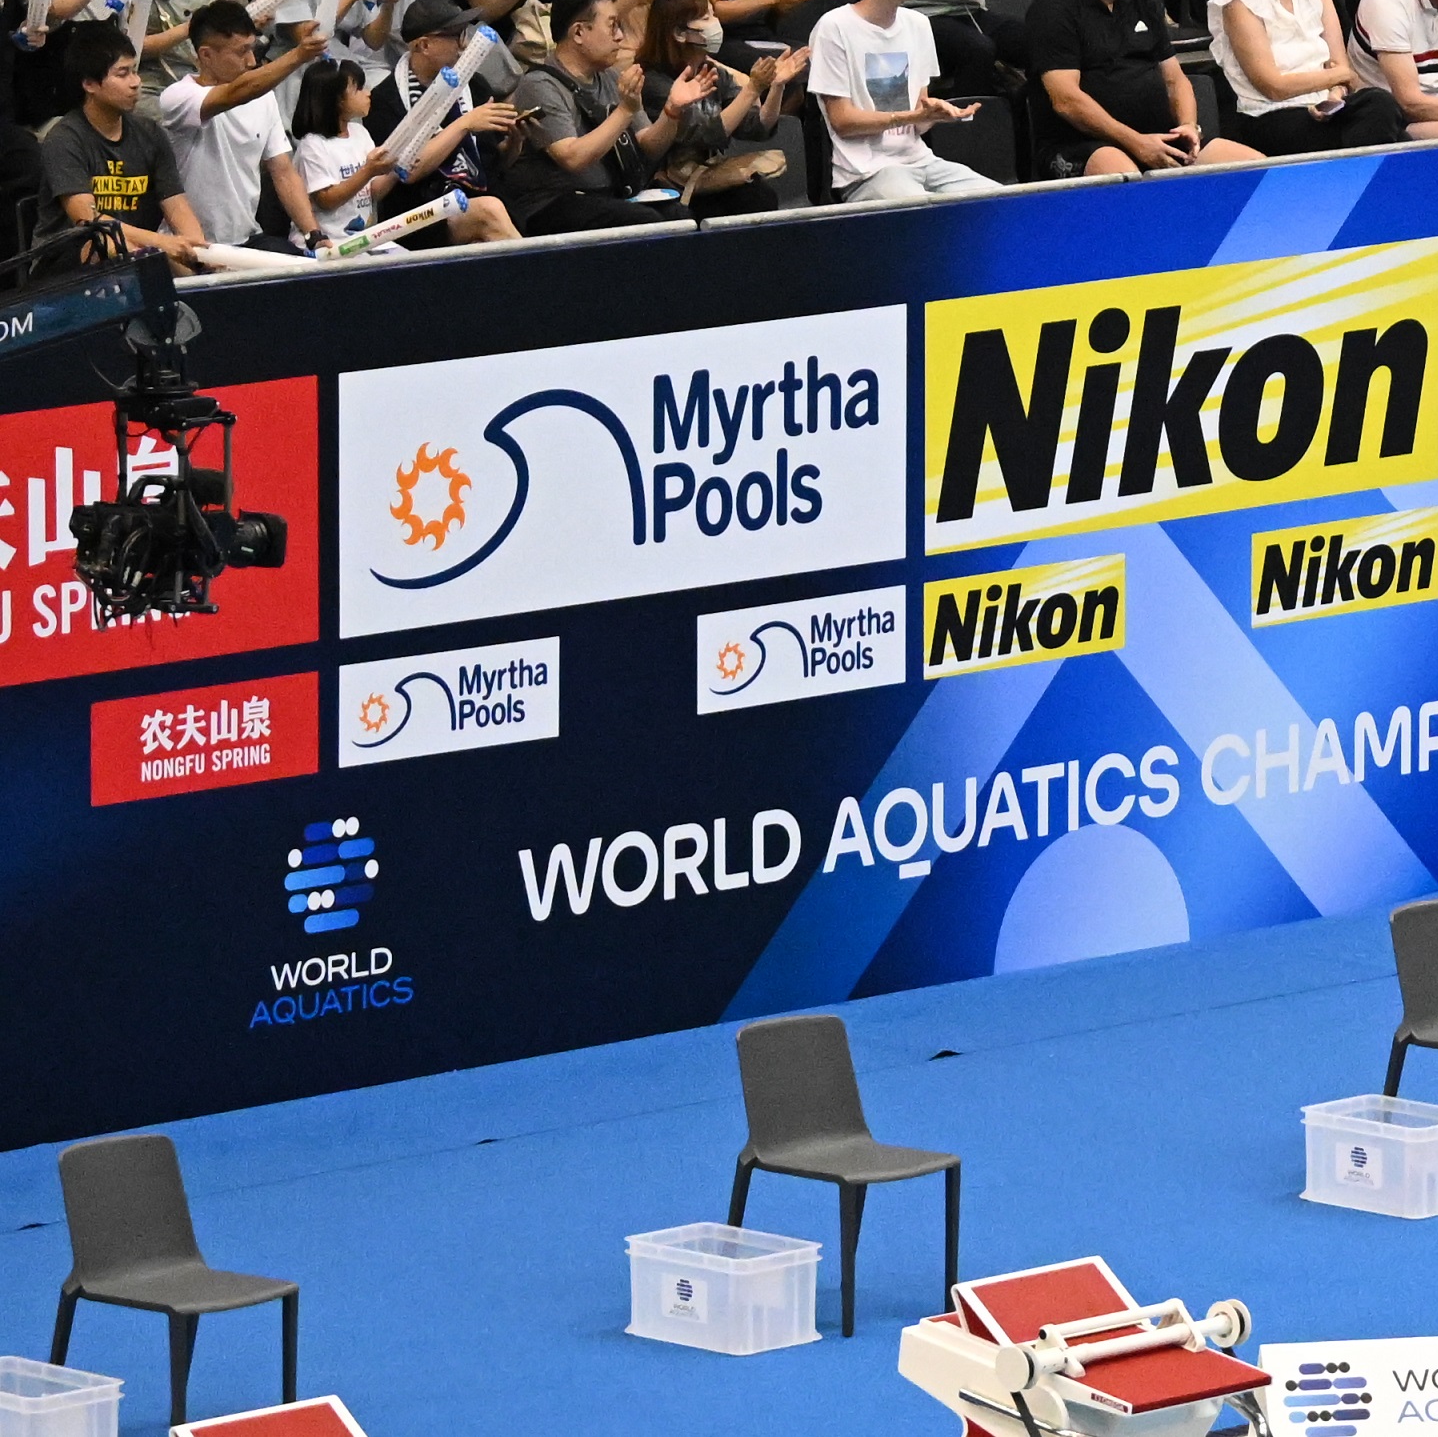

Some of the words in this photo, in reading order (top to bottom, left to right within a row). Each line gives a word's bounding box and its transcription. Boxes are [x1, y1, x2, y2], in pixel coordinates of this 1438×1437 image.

[105, 160, 123, 175] BE
[404, 206, 436, 225] Nikon
[652, 355, 881, 466] Myrtha
[936, 305, 1429, 524] Nikon
[652, 446, 823, 544] Pools
[1256, 533, 1437, 615] Nikon
[810, 605, 895, 648] Myrtha
[928, 583, 1119, 667] Nikon
[458, 657, 548, 699] Myrtha
[810, 639, 874, 679] Pools
[140, 695, 272, 754] 农夫山泉
[458, 692, 526, 732] Pools
[140, 751, 206, 782] NONGFU
[210, 742, 272, 773] SPRING
[518, 808, 801, 922] WORLD
[823, 744, 1181, 879] AQUATICS
[270, 946, 393, 991] WORLD
[249, 975, 415, 1029] AQUATICS
